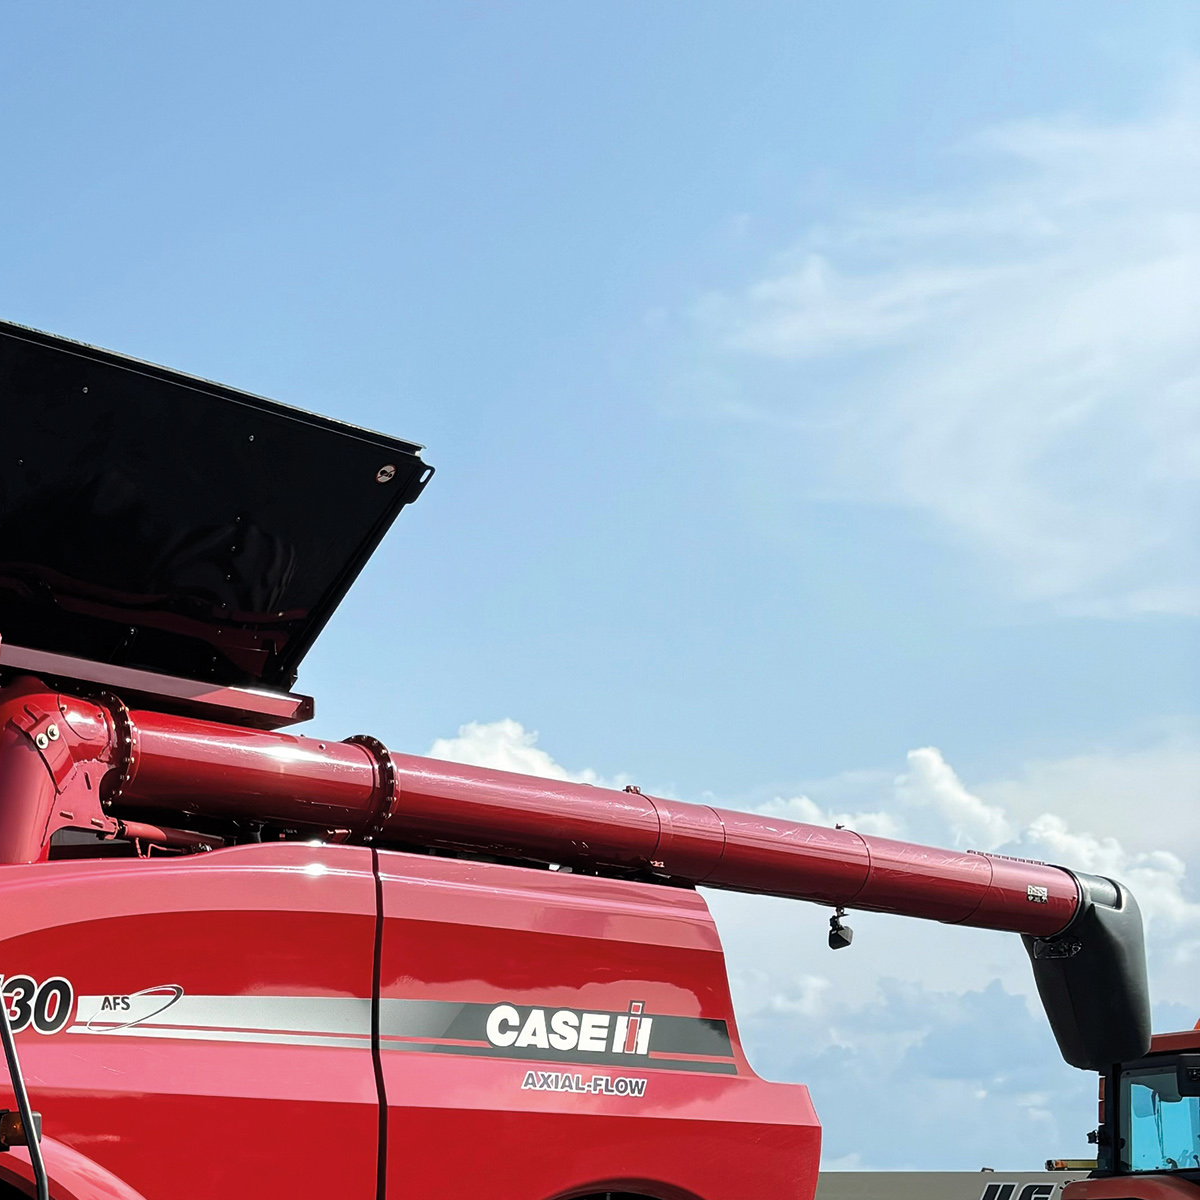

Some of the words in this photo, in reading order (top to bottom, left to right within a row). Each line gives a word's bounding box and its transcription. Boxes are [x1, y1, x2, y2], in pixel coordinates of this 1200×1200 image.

[101, 996, 131, 1011] AFS
[486, 1004, 610, 1052] CASE
[522, 1071, 647, 1097] AXIAL-FLOW
